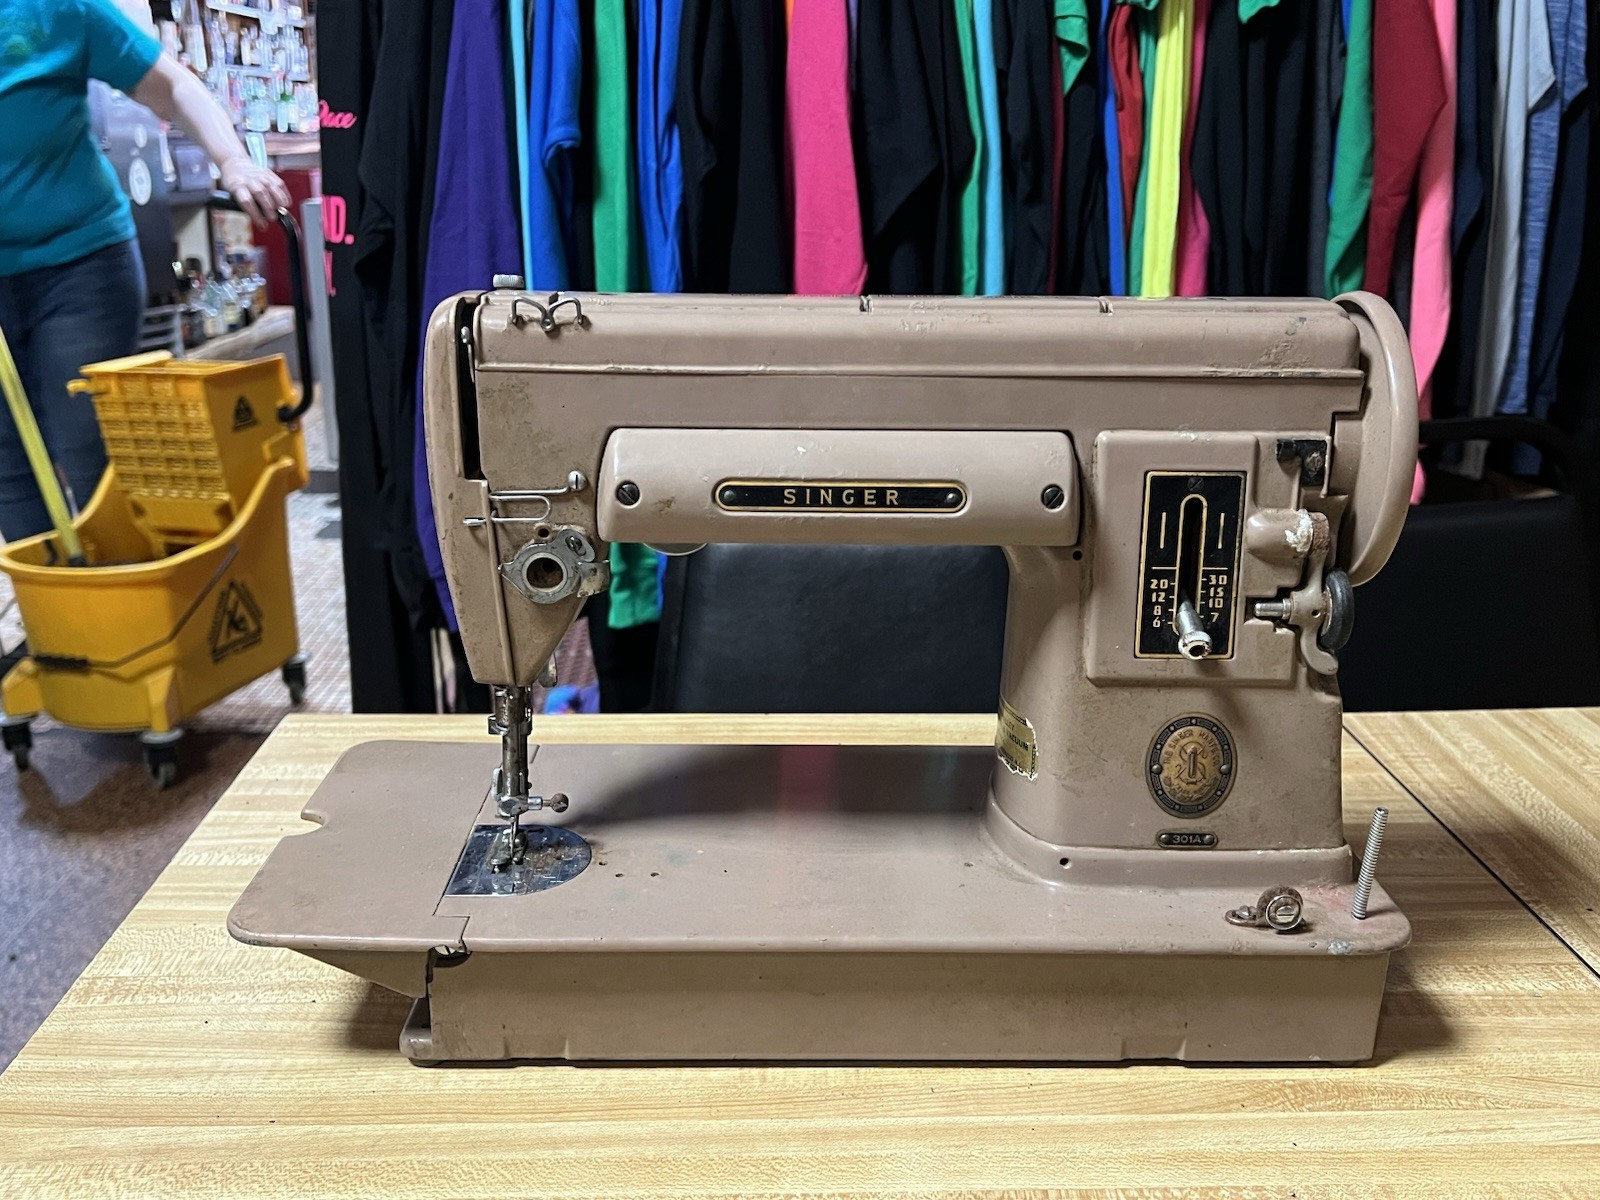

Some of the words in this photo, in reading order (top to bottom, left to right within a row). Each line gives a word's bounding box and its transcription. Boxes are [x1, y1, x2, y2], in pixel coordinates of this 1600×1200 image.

[783, 489, 898, 505] SINGER
[1150, 579, 1168, 590] 20
[1209, 575, 1227, 585] 30
[1151, 592, 1166, 602] 12
[1209, 587, 1224, 597] 15
[1208, 598, 1223, 608] 10
[1153, 605, 1162, 616] 8
[1152, 616, 1161, 627] 6
[1211, 612, 1219, 622] 7
[1172, 835, 1202, 844] 301A
